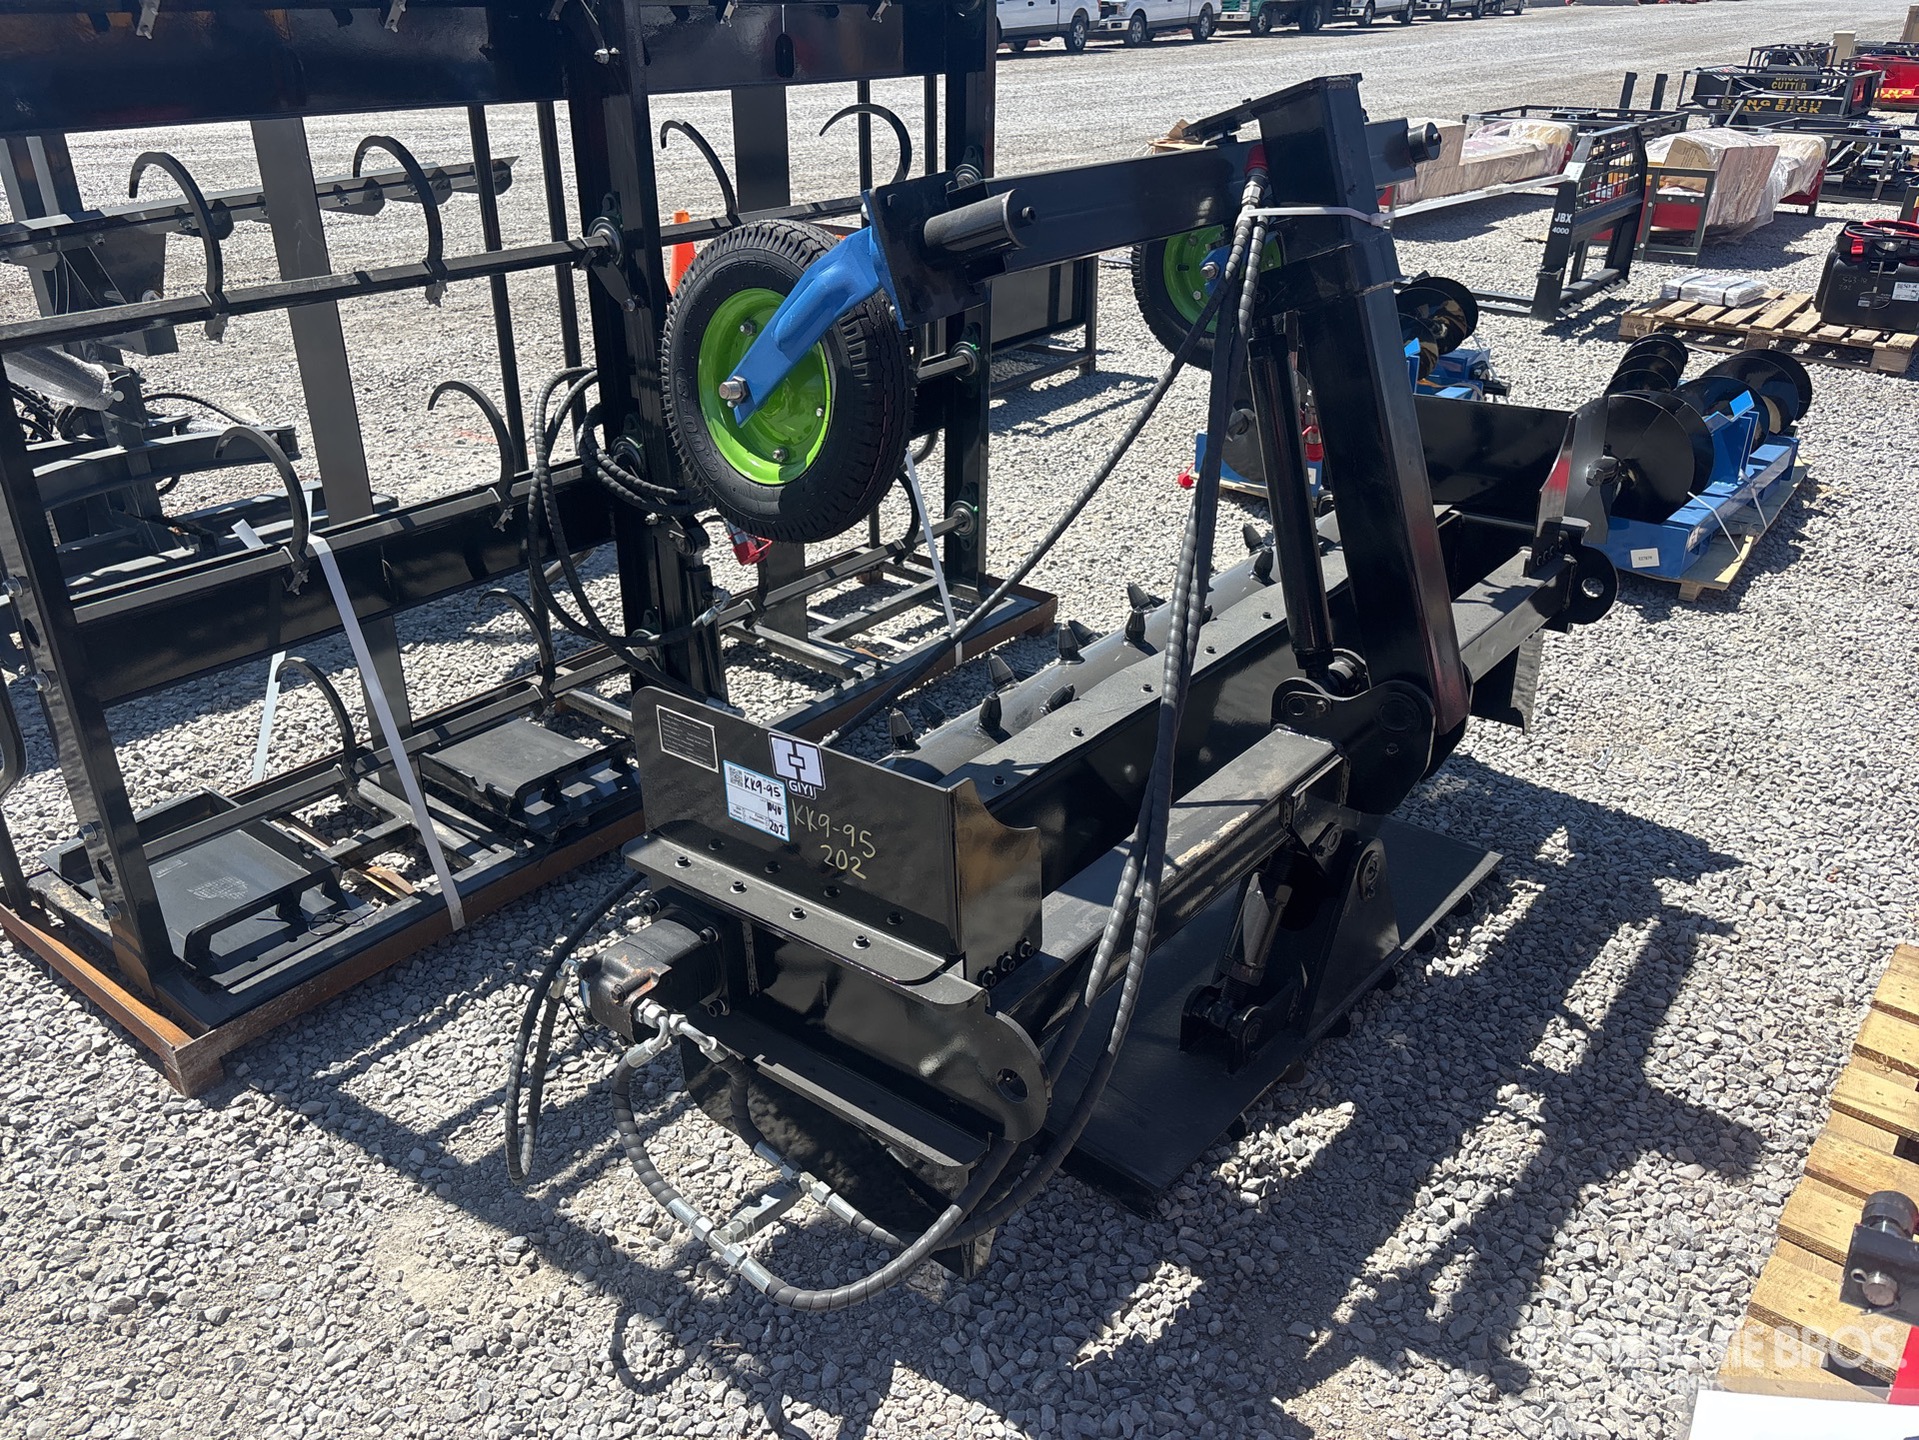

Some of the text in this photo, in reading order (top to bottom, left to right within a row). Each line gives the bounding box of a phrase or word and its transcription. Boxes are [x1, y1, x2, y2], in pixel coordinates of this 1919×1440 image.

[1554, 212, 1573, 224] JBX
[1551, 226, 1570, 235] 4000
[744, 774, 781, 797] KK9-95
[788, 779, 814, 797] GIYI
[768, 819, 786, 837] 202
[791, 798, 876, 859] KK9-95
[820, 844, 867, 880] 202
